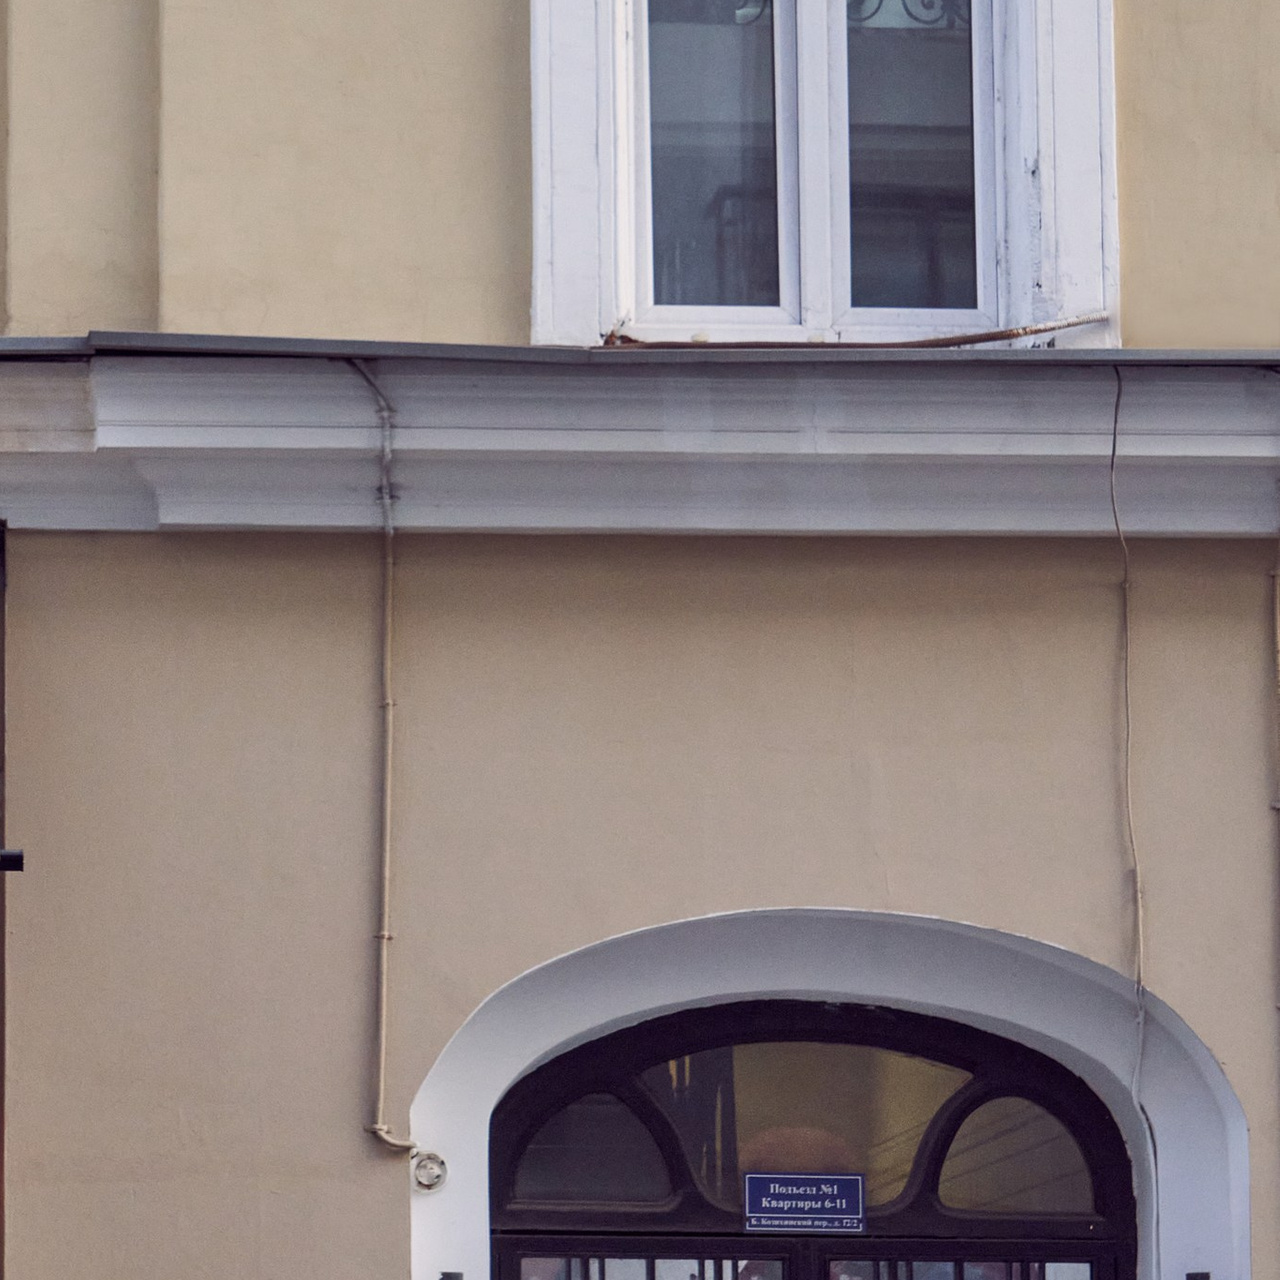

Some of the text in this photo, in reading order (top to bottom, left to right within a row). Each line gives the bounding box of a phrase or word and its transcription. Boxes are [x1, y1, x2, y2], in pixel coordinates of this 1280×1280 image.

[770, 1183, 838, 1195] Подъезд №1
[761, 1197, 847, 1210] Квартиры 6-11
